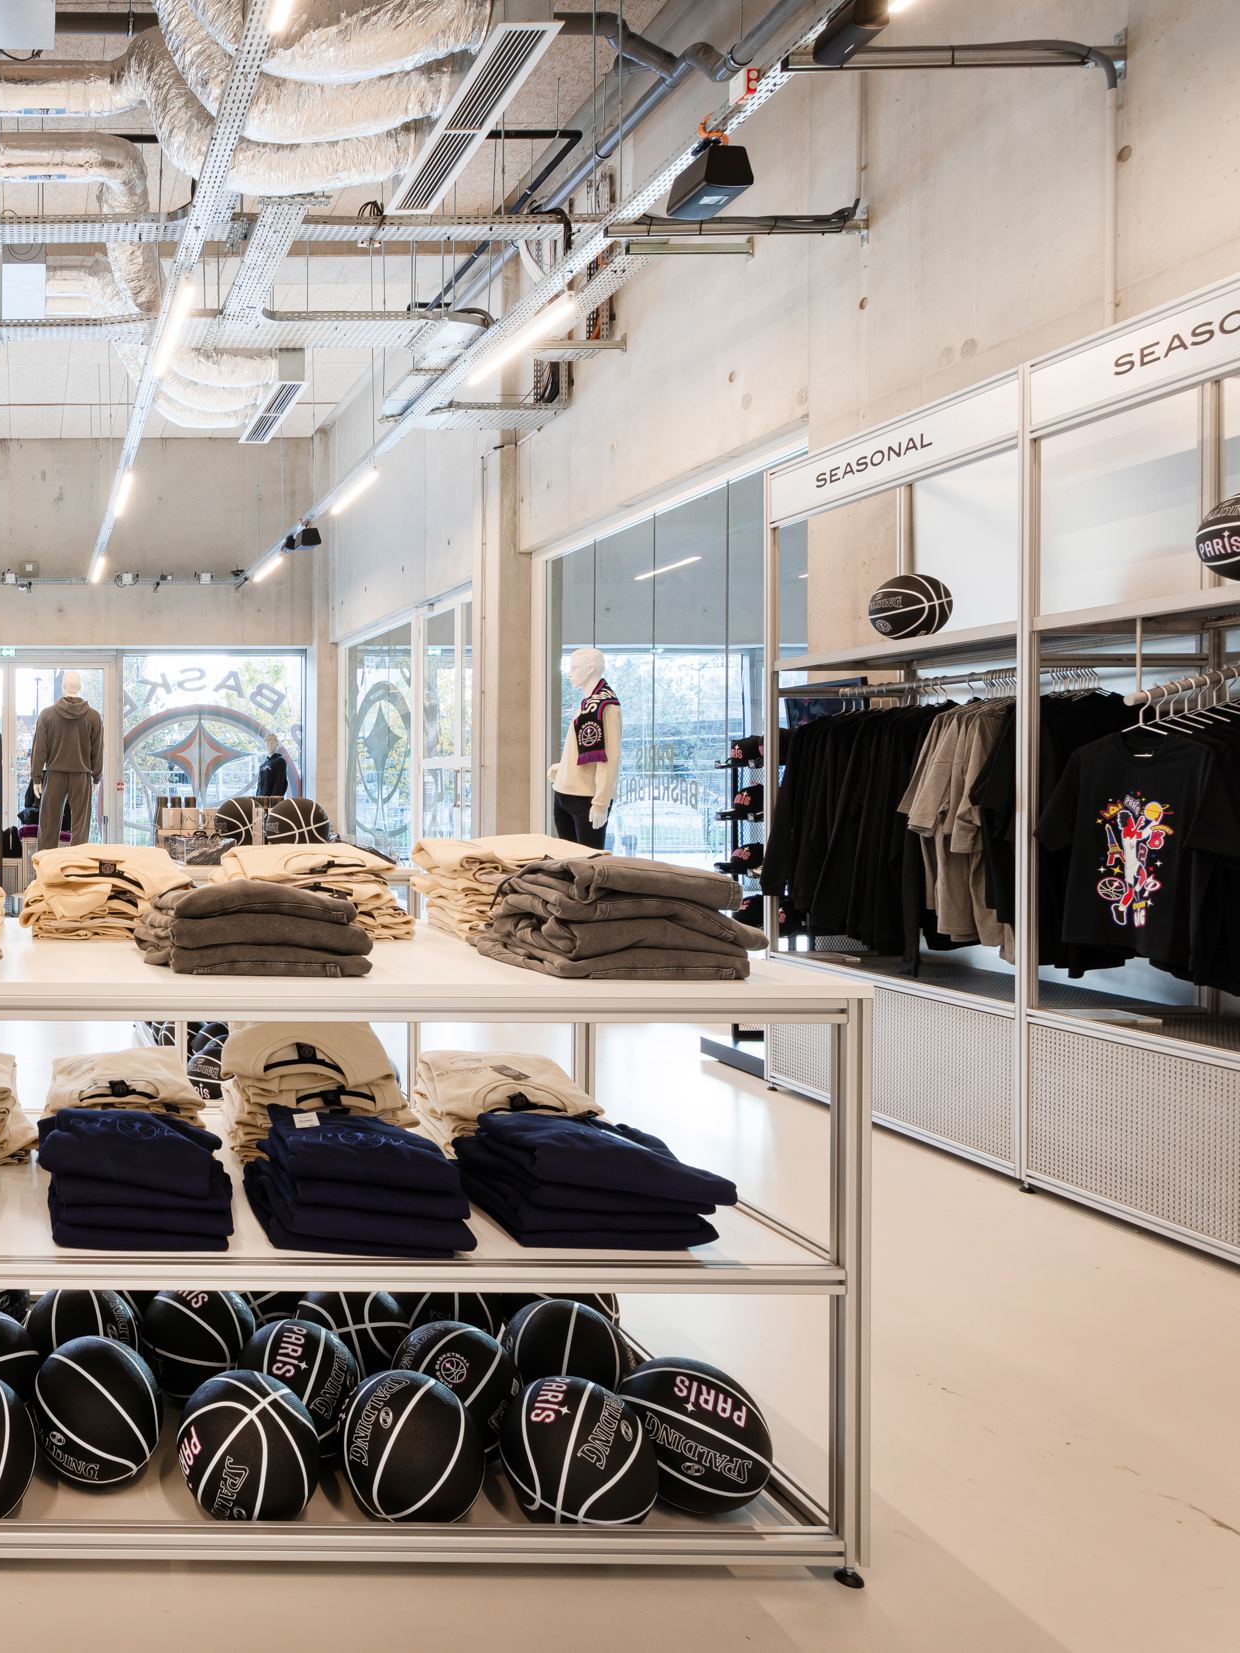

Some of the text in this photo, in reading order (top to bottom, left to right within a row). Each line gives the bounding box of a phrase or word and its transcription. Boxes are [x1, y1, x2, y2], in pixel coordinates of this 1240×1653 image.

[815, 433, 933, 488] SEASONAL
[1199, 531, 1240, 559] PARIS
[272, 1325, 307, 1377] PARIS
[310, 1347, 348, 1420] ALDING
[530, 1377, 571, 1423] PARIS
[674, 1375, 747, 1428] PARIS
[350, 1376, 411, 1466] SPALDING
[577, 1391, 626, 1470] PALDING
[645, 1411, 752, 1484] SPALDING
[43, 1435, 100, 1480] LDING
[178, 1425, 201, 1482] PAR
[211, 1456, 249, 1520] SPAL
